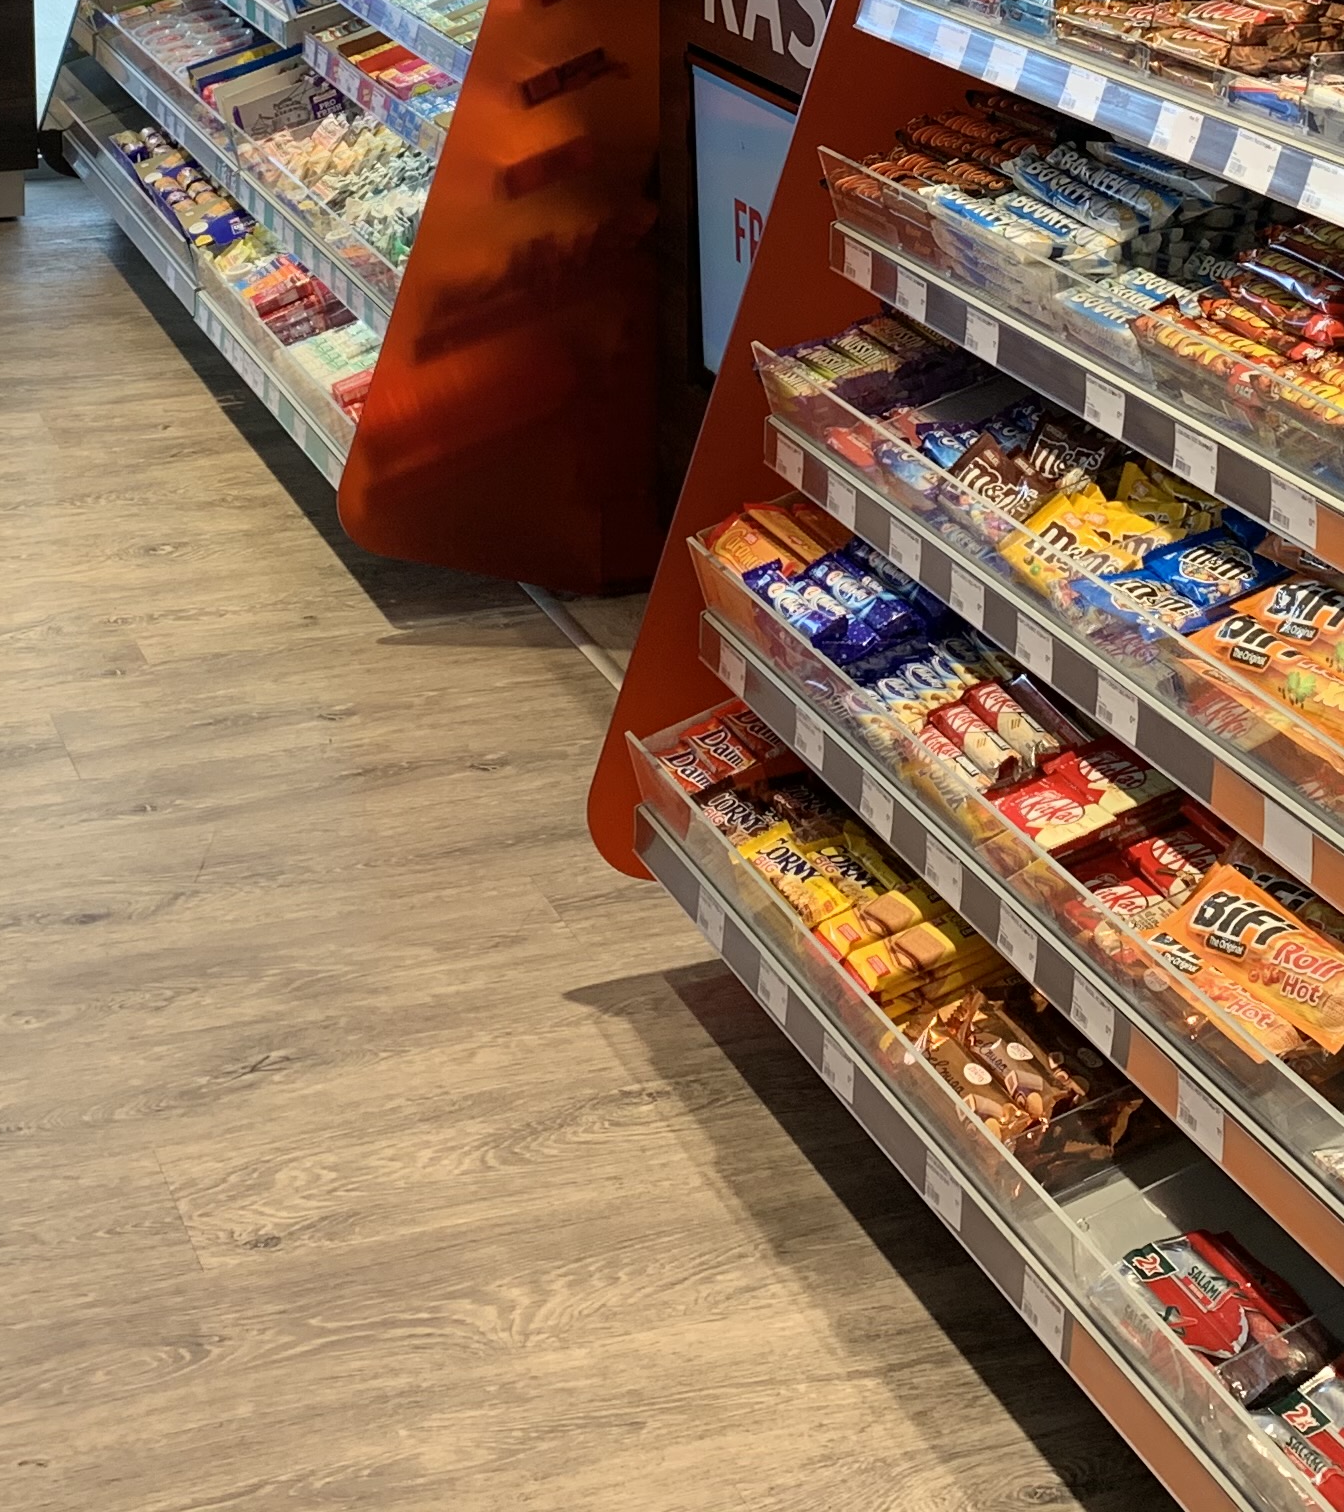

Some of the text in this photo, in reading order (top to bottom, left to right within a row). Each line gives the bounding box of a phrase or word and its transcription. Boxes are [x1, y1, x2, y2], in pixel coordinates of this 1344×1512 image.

[944, 188, 1008, 227] BOUNTY
[1011, 195, 1075, 238] BOUNTY
[944, 708, 988, 734] KitKat
[697, 725, 744, 769] Daim
[702, 806, 724, 827] BIG
[707, 789, 761, 834] CORNY
[751, 854, 778, 875] BIG
[756, 835, 824, 884] CORNY
[1193, 891, 1301, 947] BiFi
[1208, 936, 1219, 947] The
[1281, 976, 1324, 1007] Hot
[1226, 999, 1273, 1031] Hot
[1133, 1251, 1162, 1277] 2x
[1187, 1264, 1222, 1302] SALAMI
[1283, 1403, 1318, 1431] 2x
